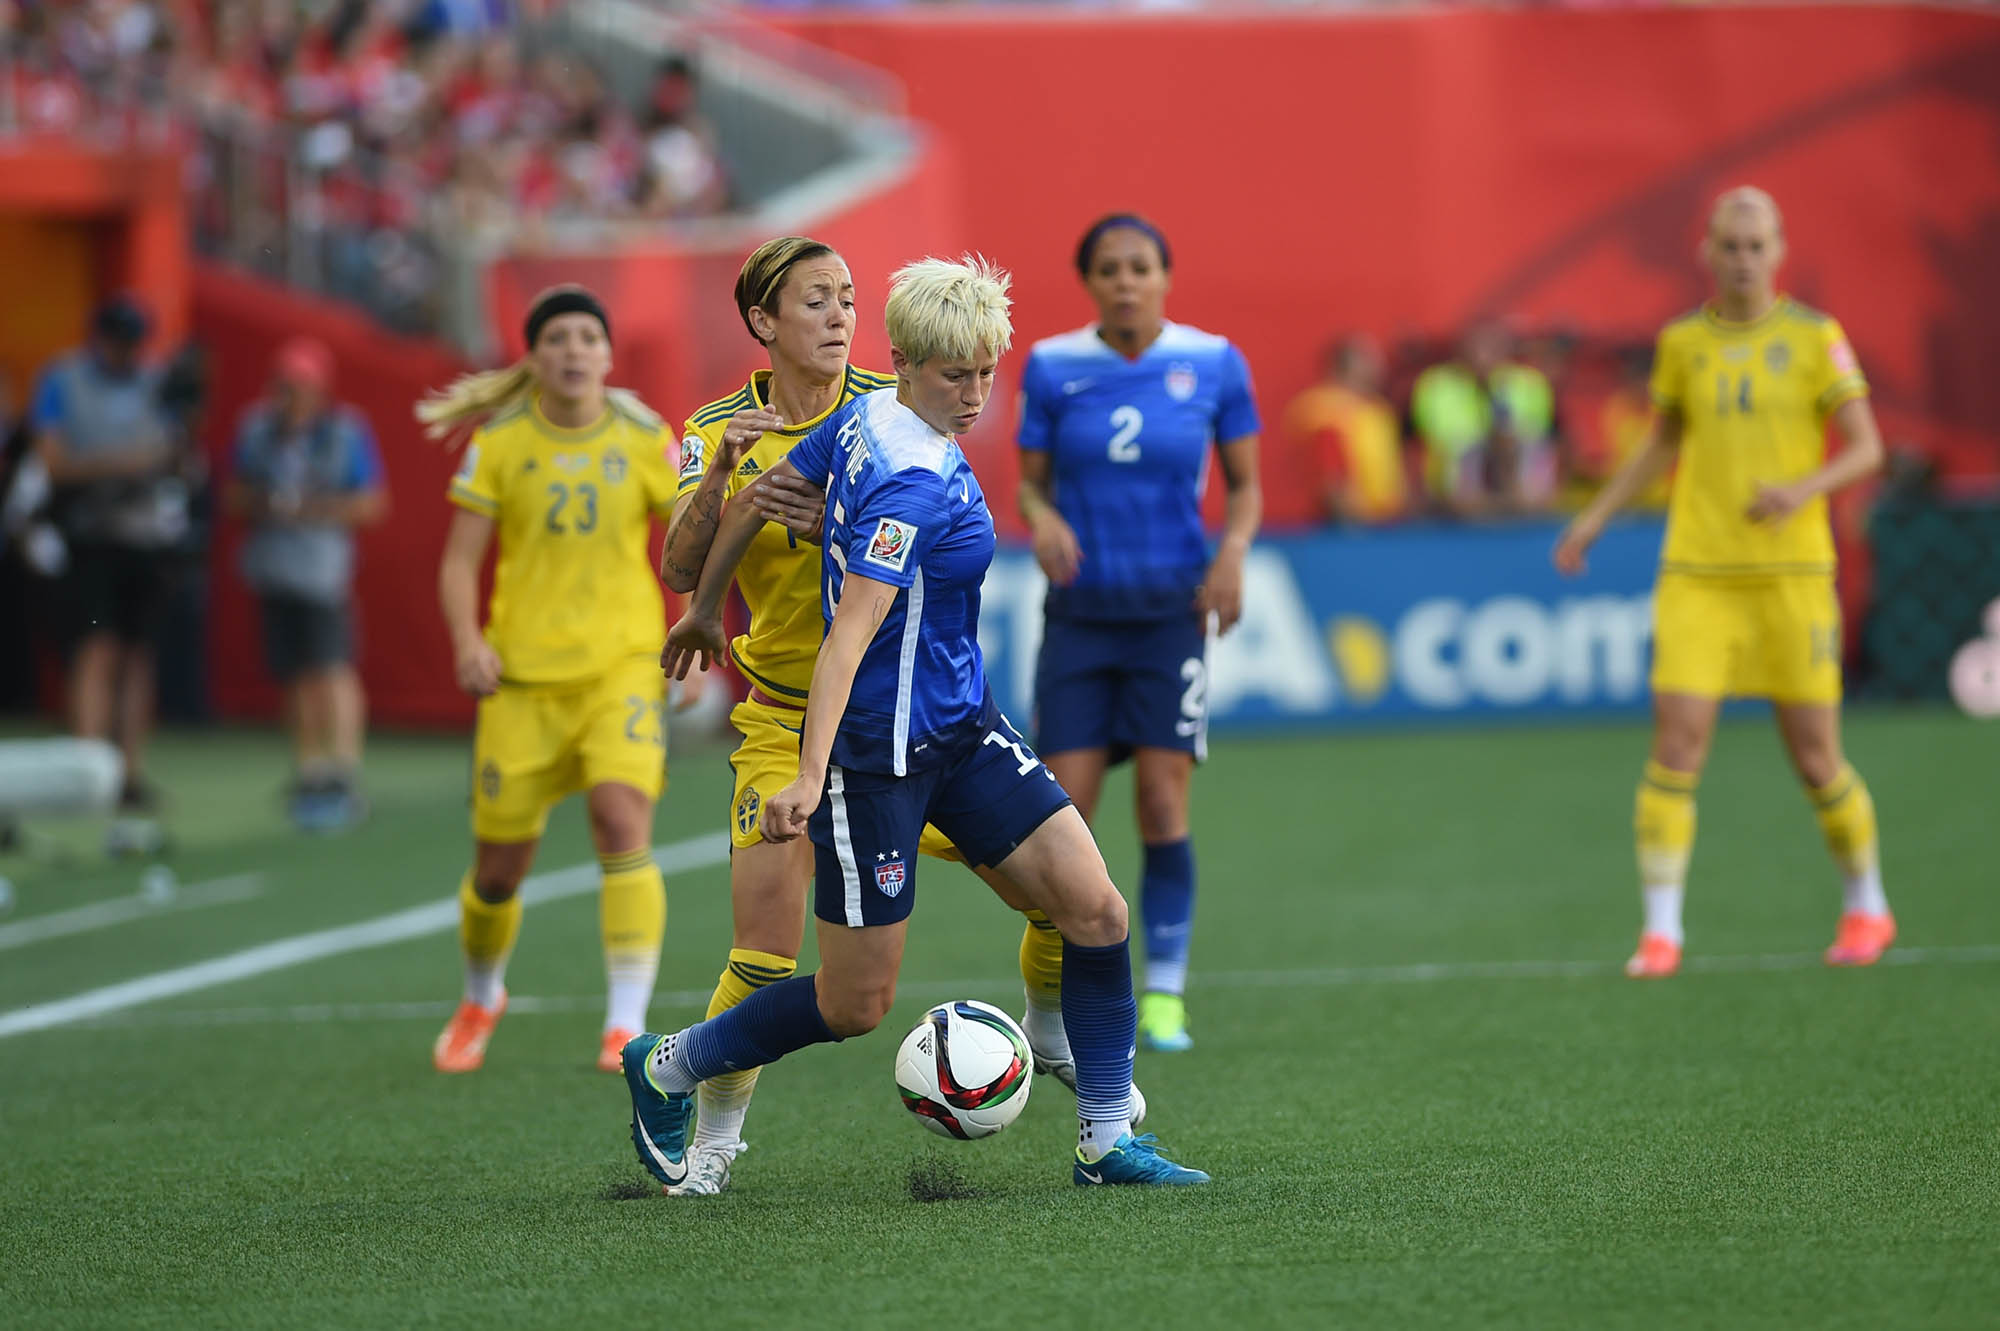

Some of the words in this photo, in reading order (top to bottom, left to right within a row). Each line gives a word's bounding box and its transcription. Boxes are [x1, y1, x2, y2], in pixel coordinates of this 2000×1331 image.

[1716, 373, 1754, 415] 14
[1107, 405, 1143, 464] 2
[546, 481, 597, 534] 23
[1180, 656, 1206, 719] 2
